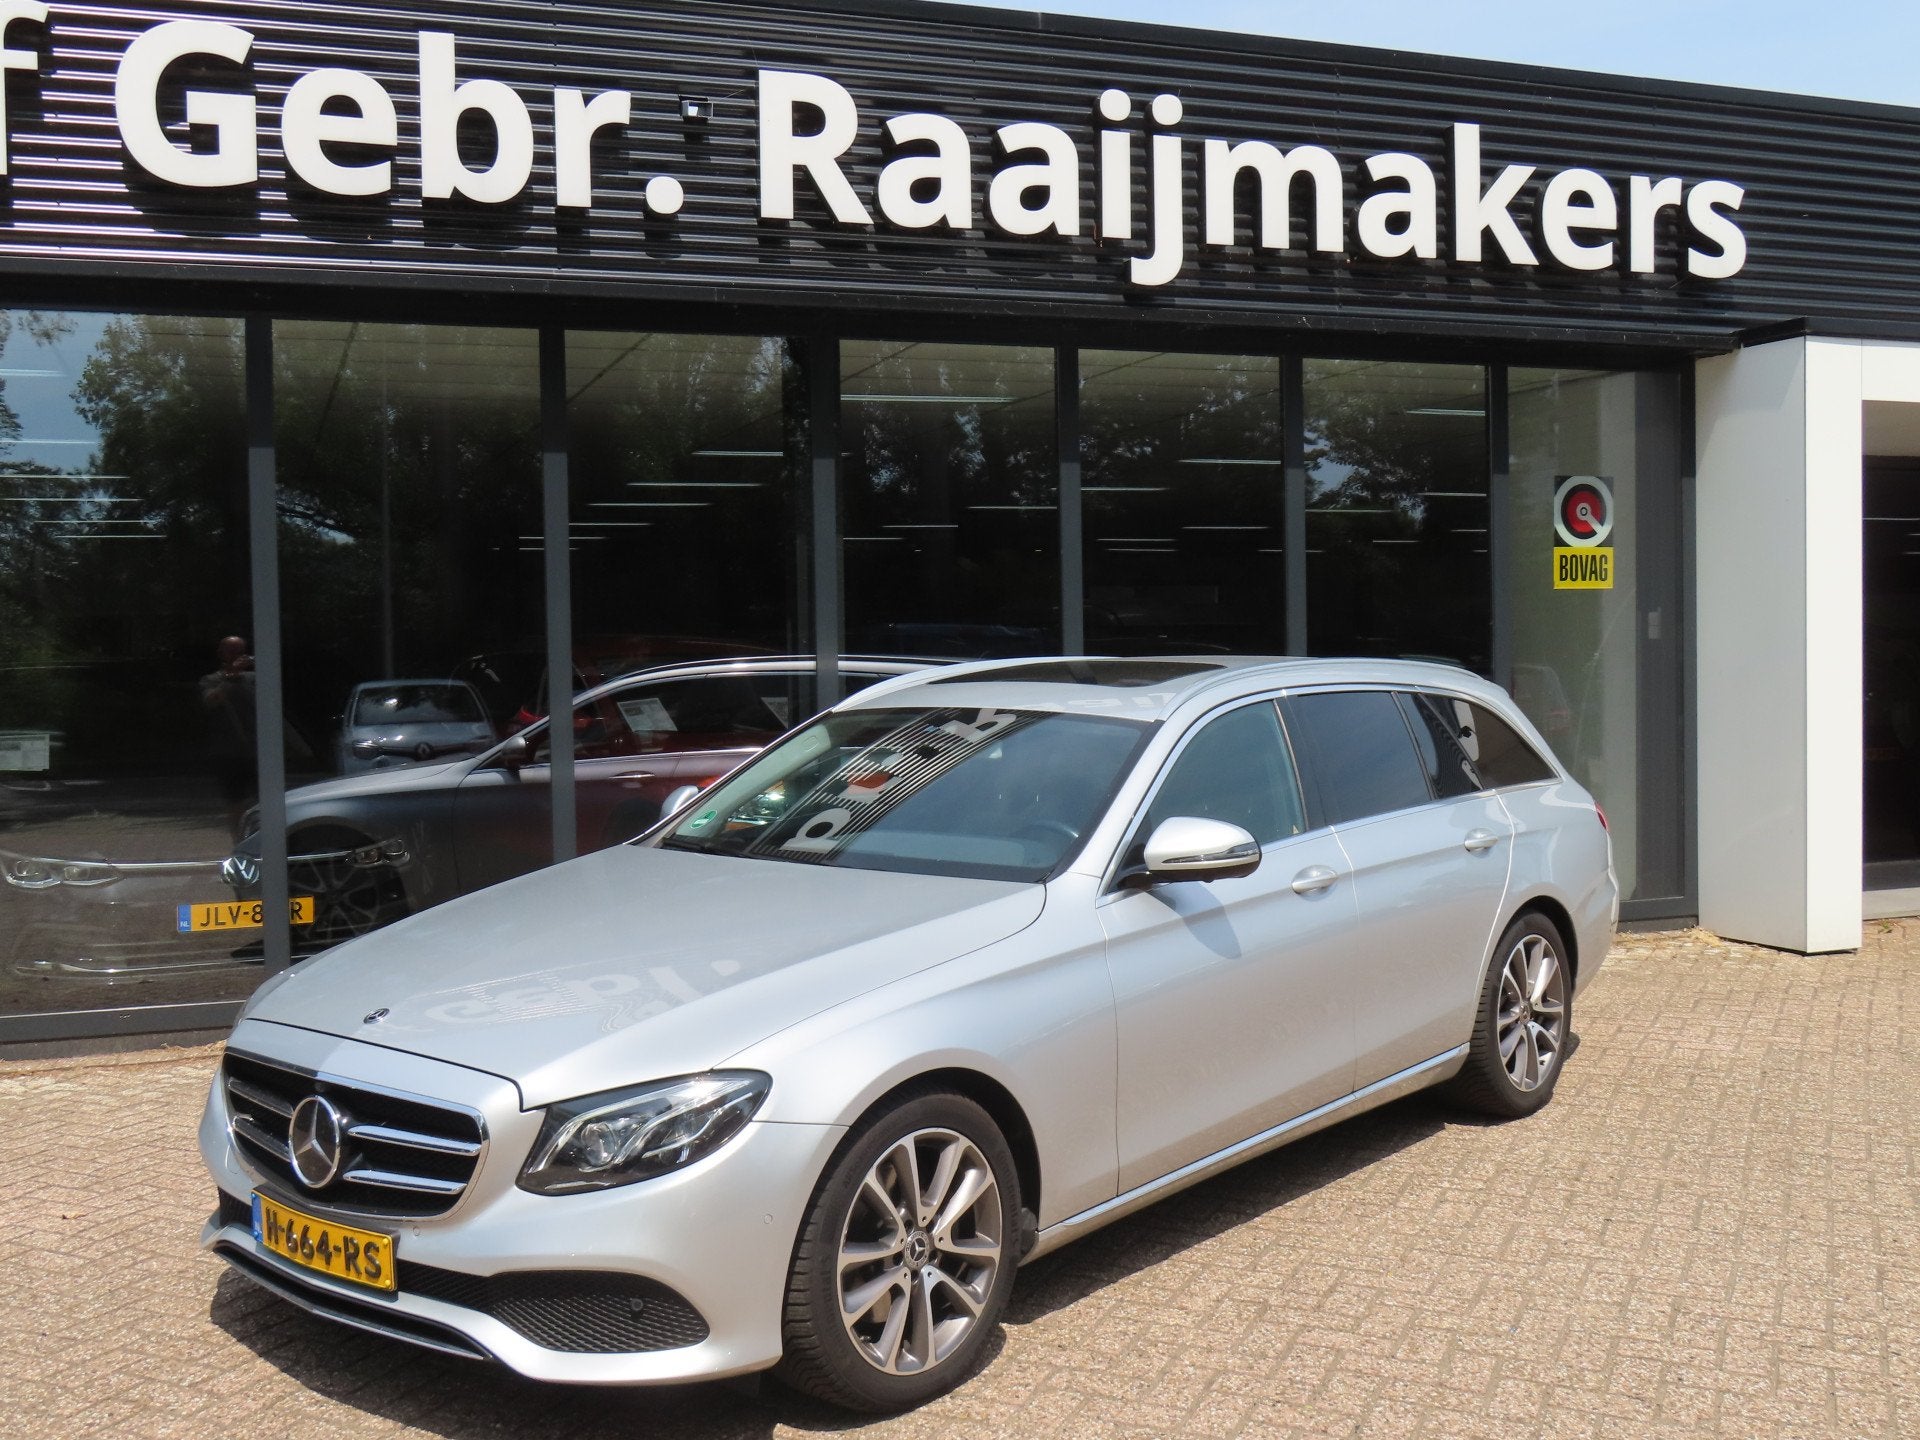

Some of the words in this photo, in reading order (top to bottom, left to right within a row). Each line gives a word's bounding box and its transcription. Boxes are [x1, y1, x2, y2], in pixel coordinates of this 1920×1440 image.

[115, 20, 684, 216] Gebr.
[758, 70, 1747, 286] Raaijmakers
[1559, 554, 1608, 582] BOVAG
[265, 1206, 382, 1279] H-664-RS
